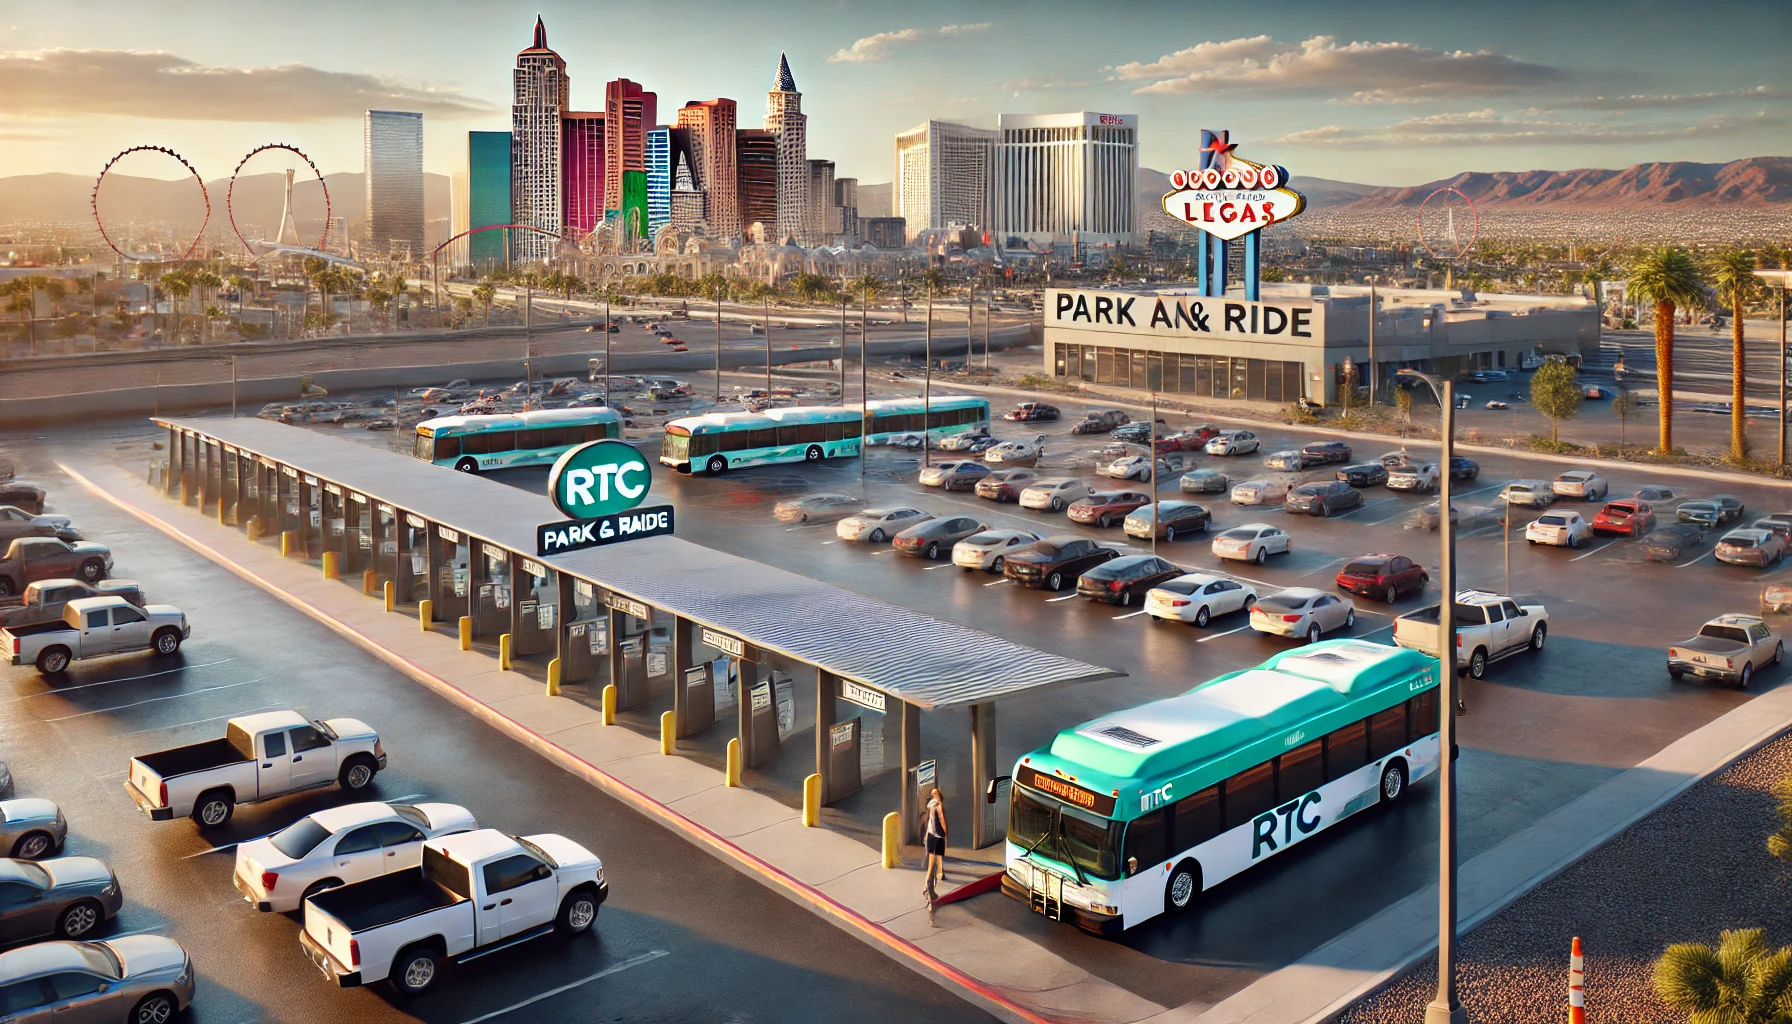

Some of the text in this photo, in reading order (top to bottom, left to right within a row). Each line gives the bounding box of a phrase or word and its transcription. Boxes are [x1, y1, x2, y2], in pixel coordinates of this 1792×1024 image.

[1057, 293, 1137, 327] PARK
[1224, 302, 1313, 338] RIDE
[566, 460, 645, 506] RTC
[544, 520, 597, 550] PARK
[1251, 791, 1322, 860] RTC
